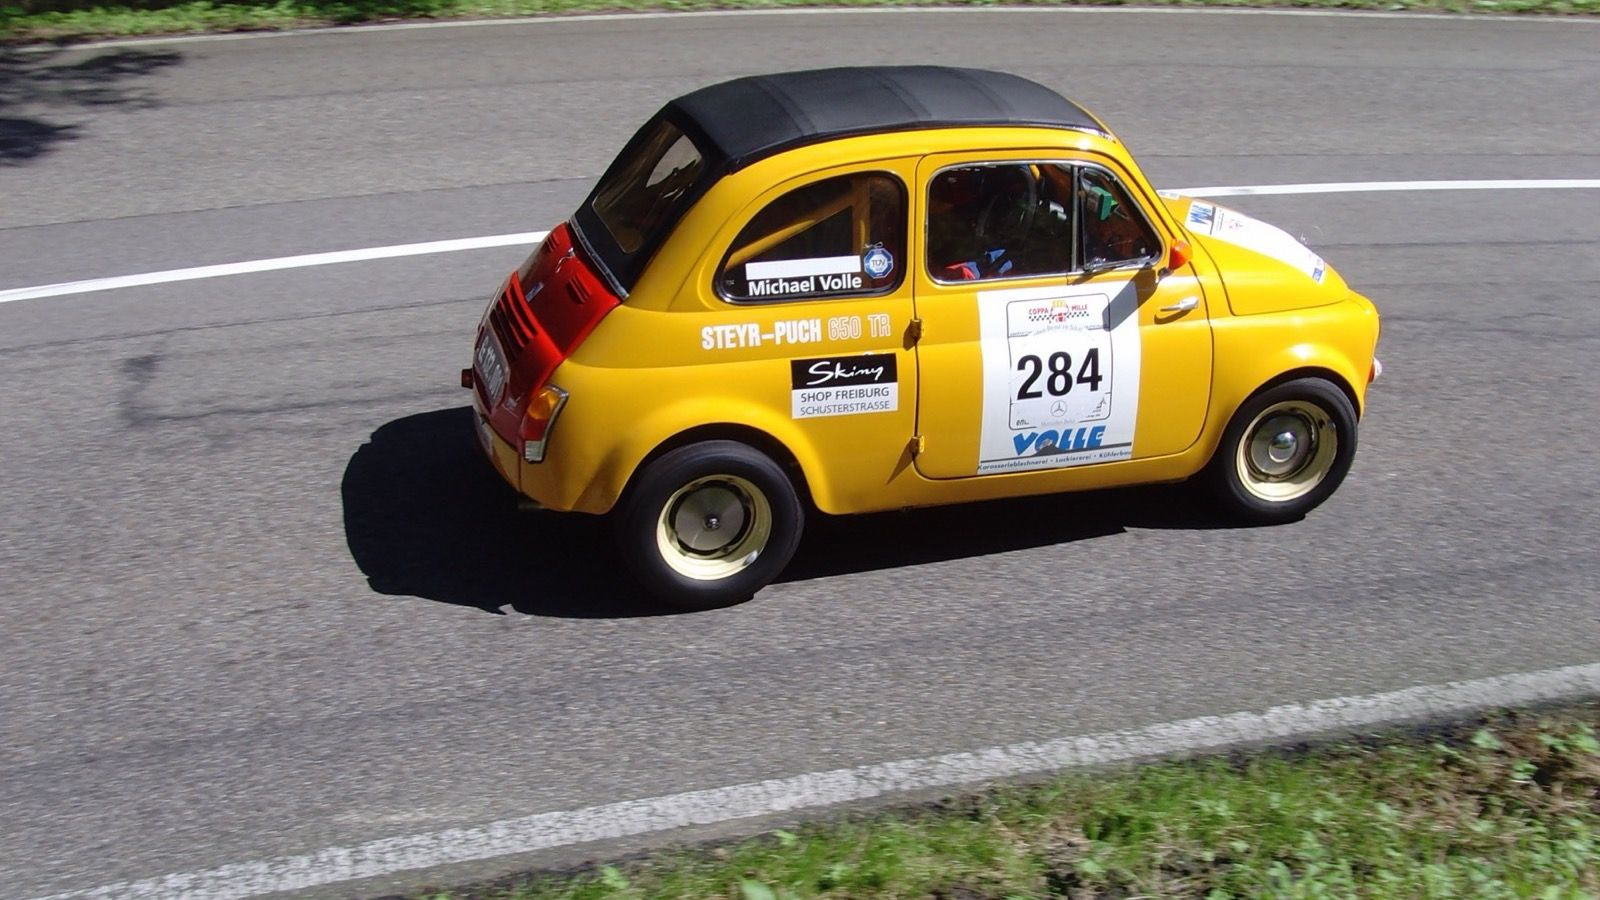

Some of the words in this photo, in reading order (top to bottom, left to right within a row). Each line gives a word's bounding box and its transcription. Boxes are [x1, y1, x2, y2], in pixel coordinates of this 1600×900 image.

[748, 275, 815, 296] Michael
[819, 273, 862, 292] Volle
[1028, 307, 1049, 315] COPPA
[1071, 304, 1089, 312] MILLE
[701, 318, 822, 350] STEYR-PUCH
[828, 317, 861, 341] 650
[868, 314, 891, 337] TR
[806, 360, 885, 386] Skiny
[1016, 347, 1103, 401] 284
[800, 390, 832, 403] SHOP
[835, 386, 890, 401] FREIBURG
[1013, 425, 1106, 457] VOLLE
